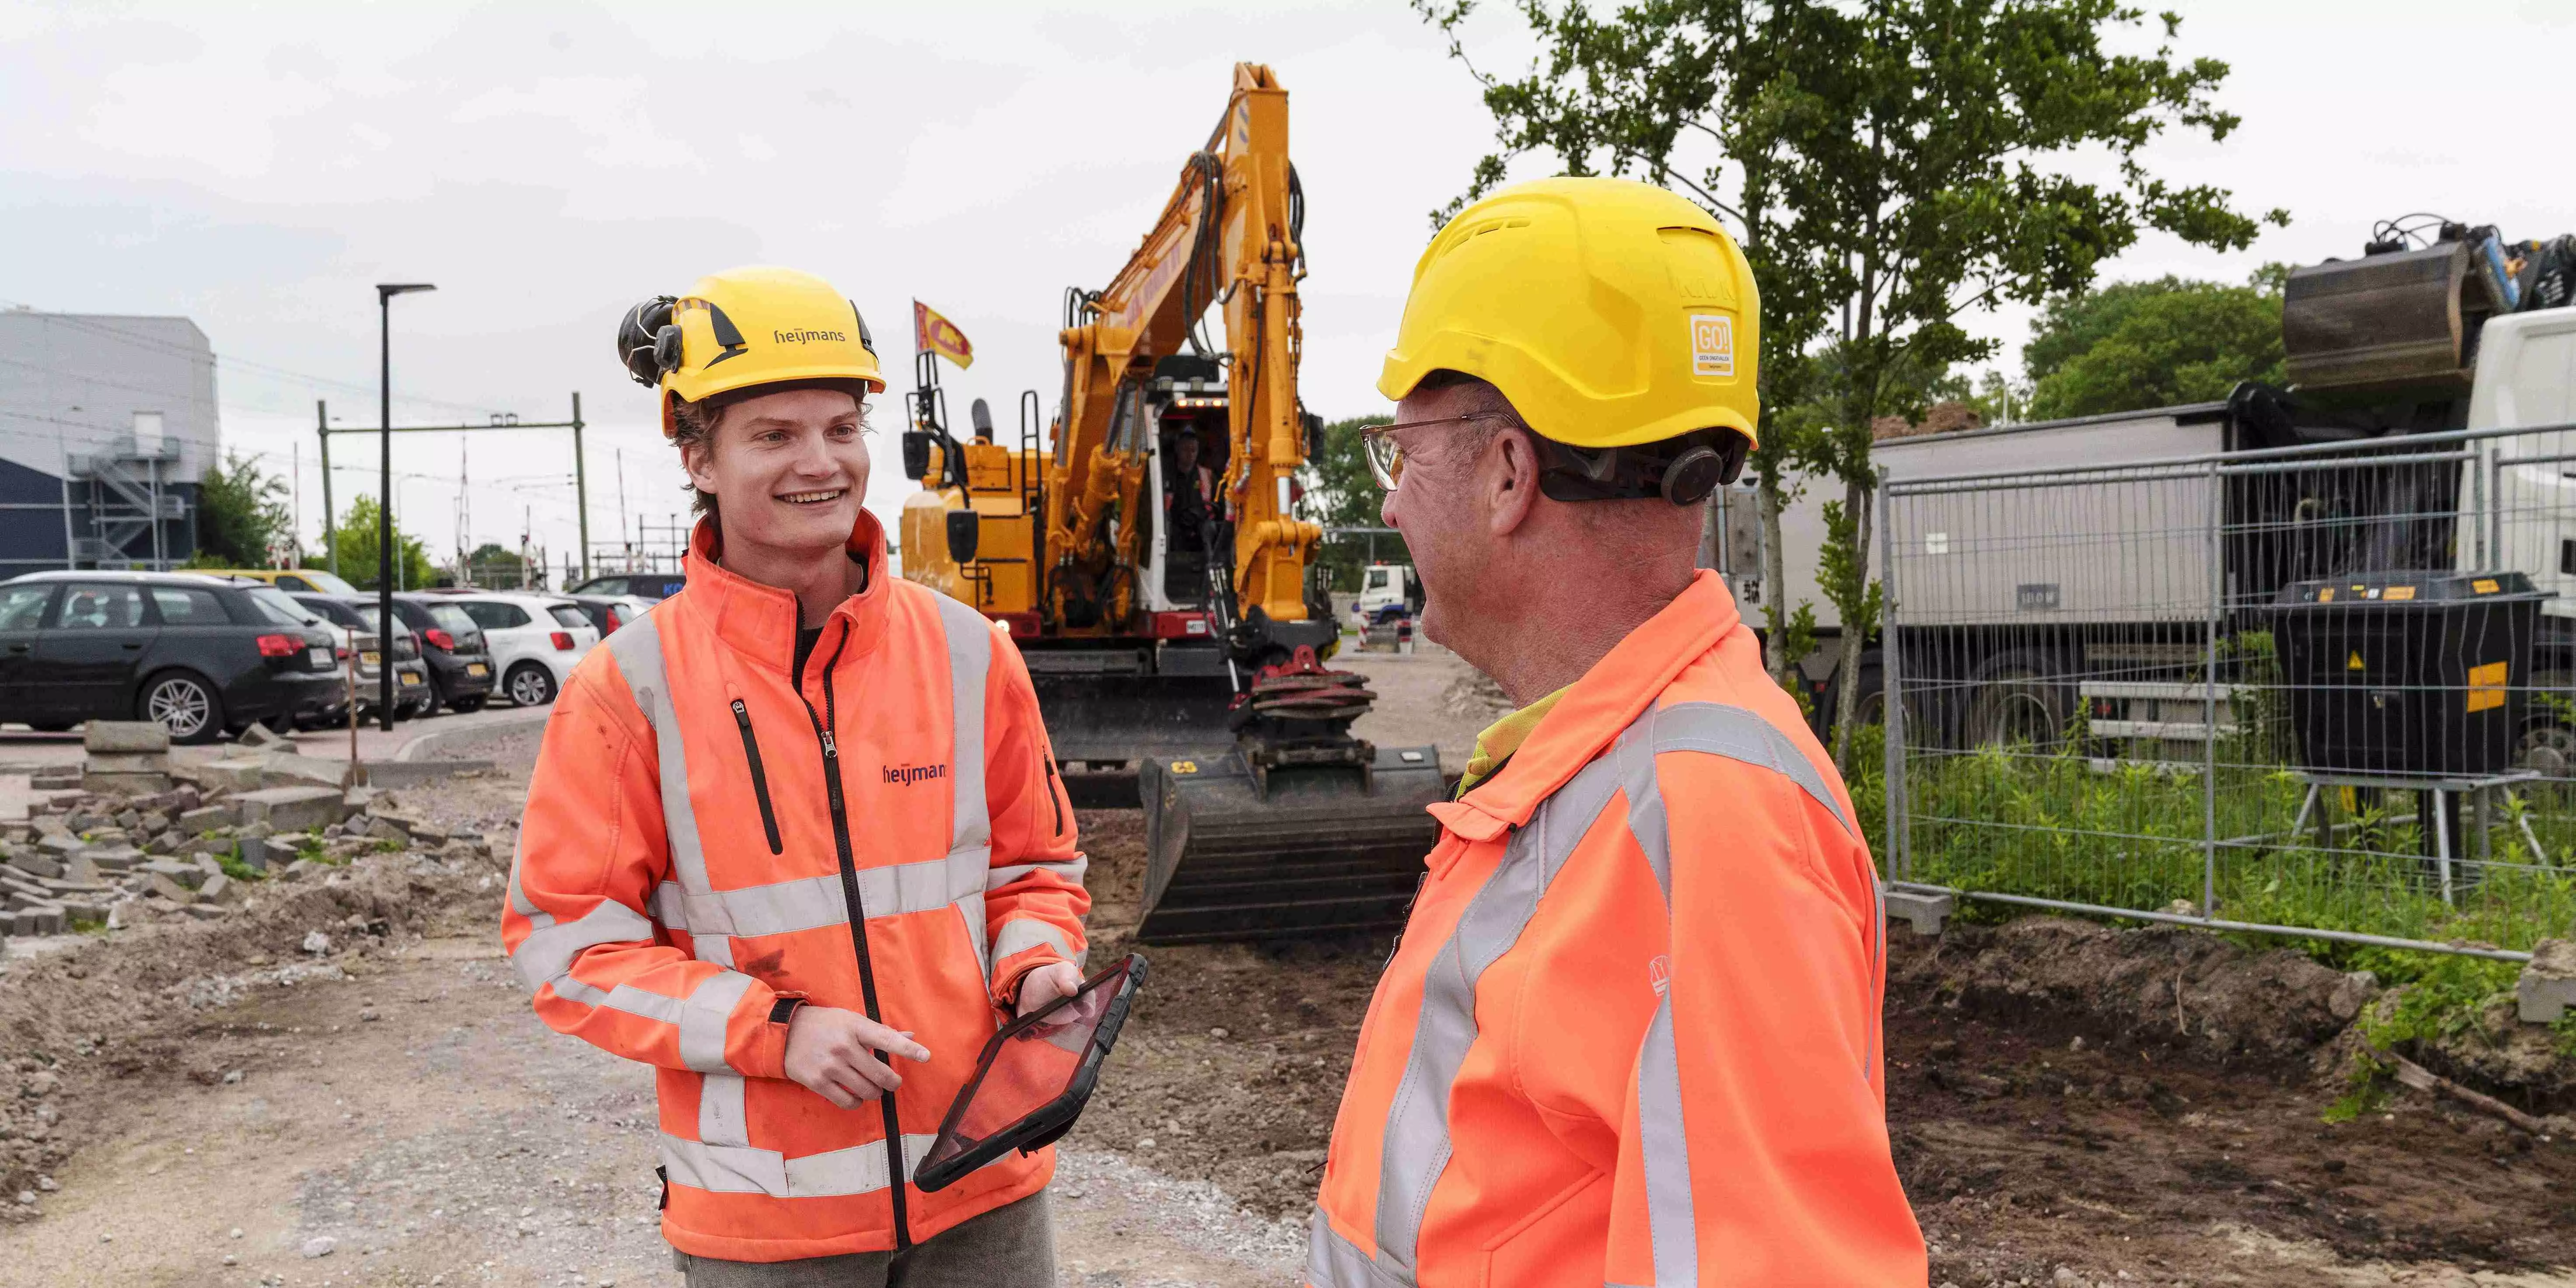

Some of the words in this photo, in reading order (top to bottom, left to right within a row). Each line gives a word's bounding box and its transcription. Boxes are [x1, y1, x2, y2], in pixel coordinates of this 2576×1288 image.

[774, 328, 846, 345] heijmans
[1699, 326, 1728, 350] GO!
[883, 763, 947, 787] heijman
